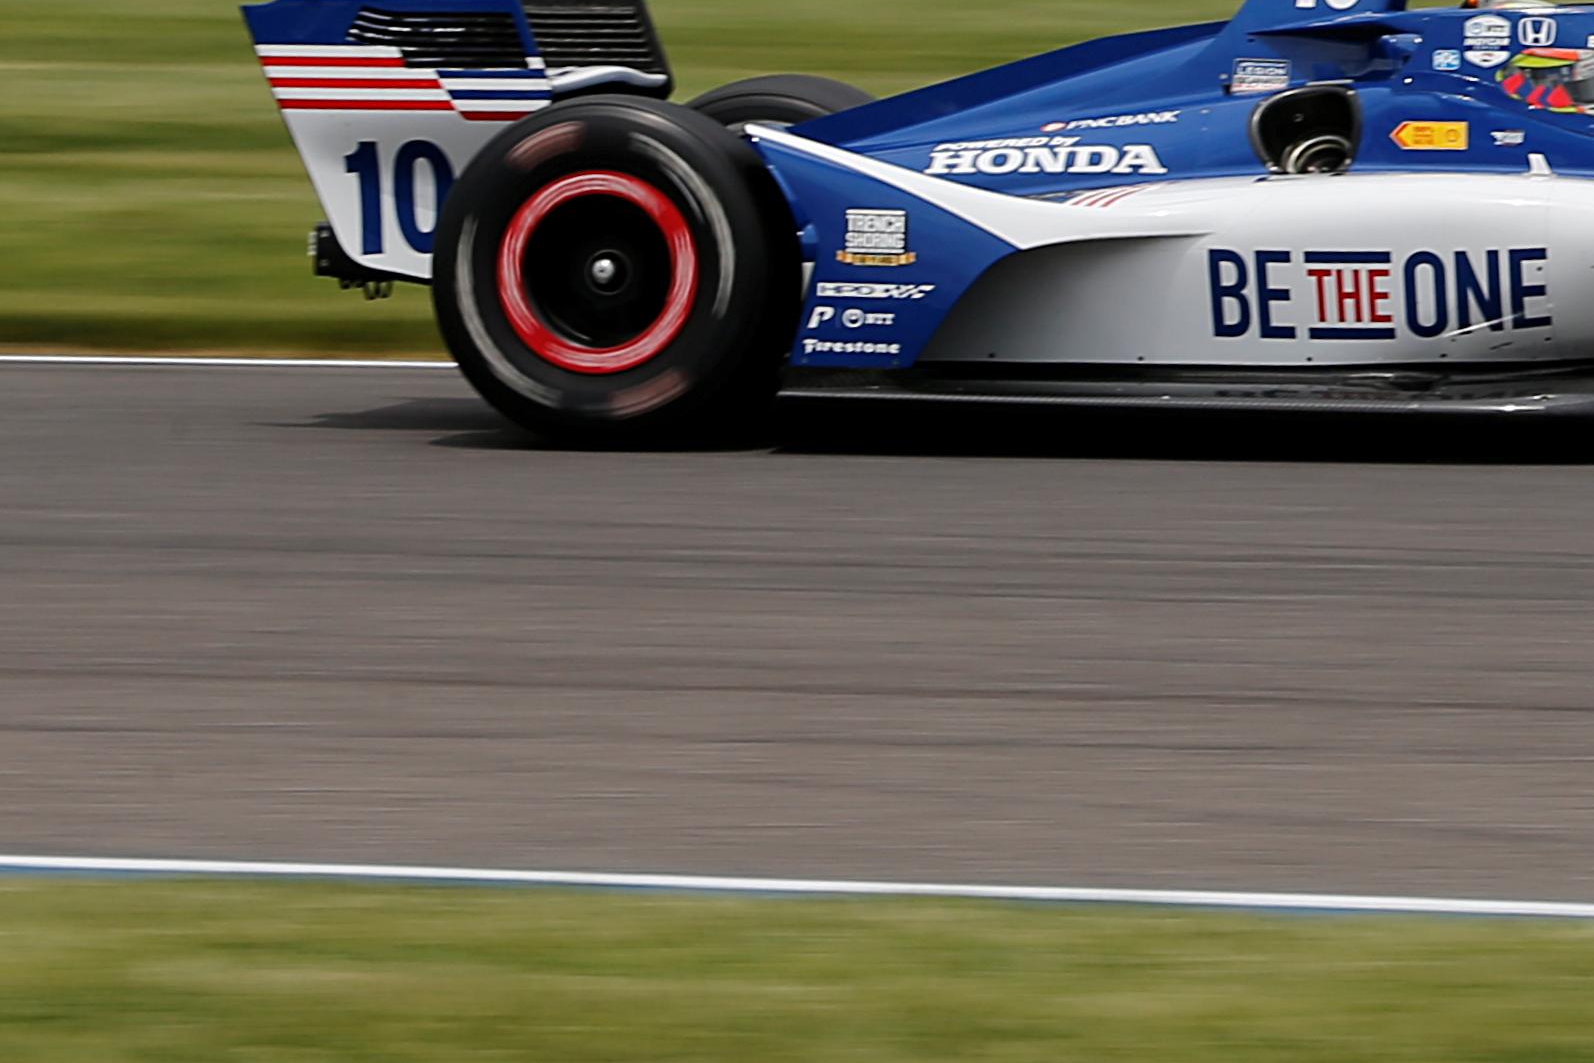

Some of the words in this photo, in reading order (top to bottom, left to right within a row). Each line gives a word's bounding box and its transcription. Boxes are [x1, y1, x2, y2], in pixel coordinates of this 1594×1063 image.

[924, 145, 1169, 175] HONDA
[343, 139, 455, 256] 10
[1207, 248, 1297, 339] BE
[1306, 269, 1394, 323] THE
[1403, 248, 1553, 338] ONE
[802, 338, 901, 354] Firestone
